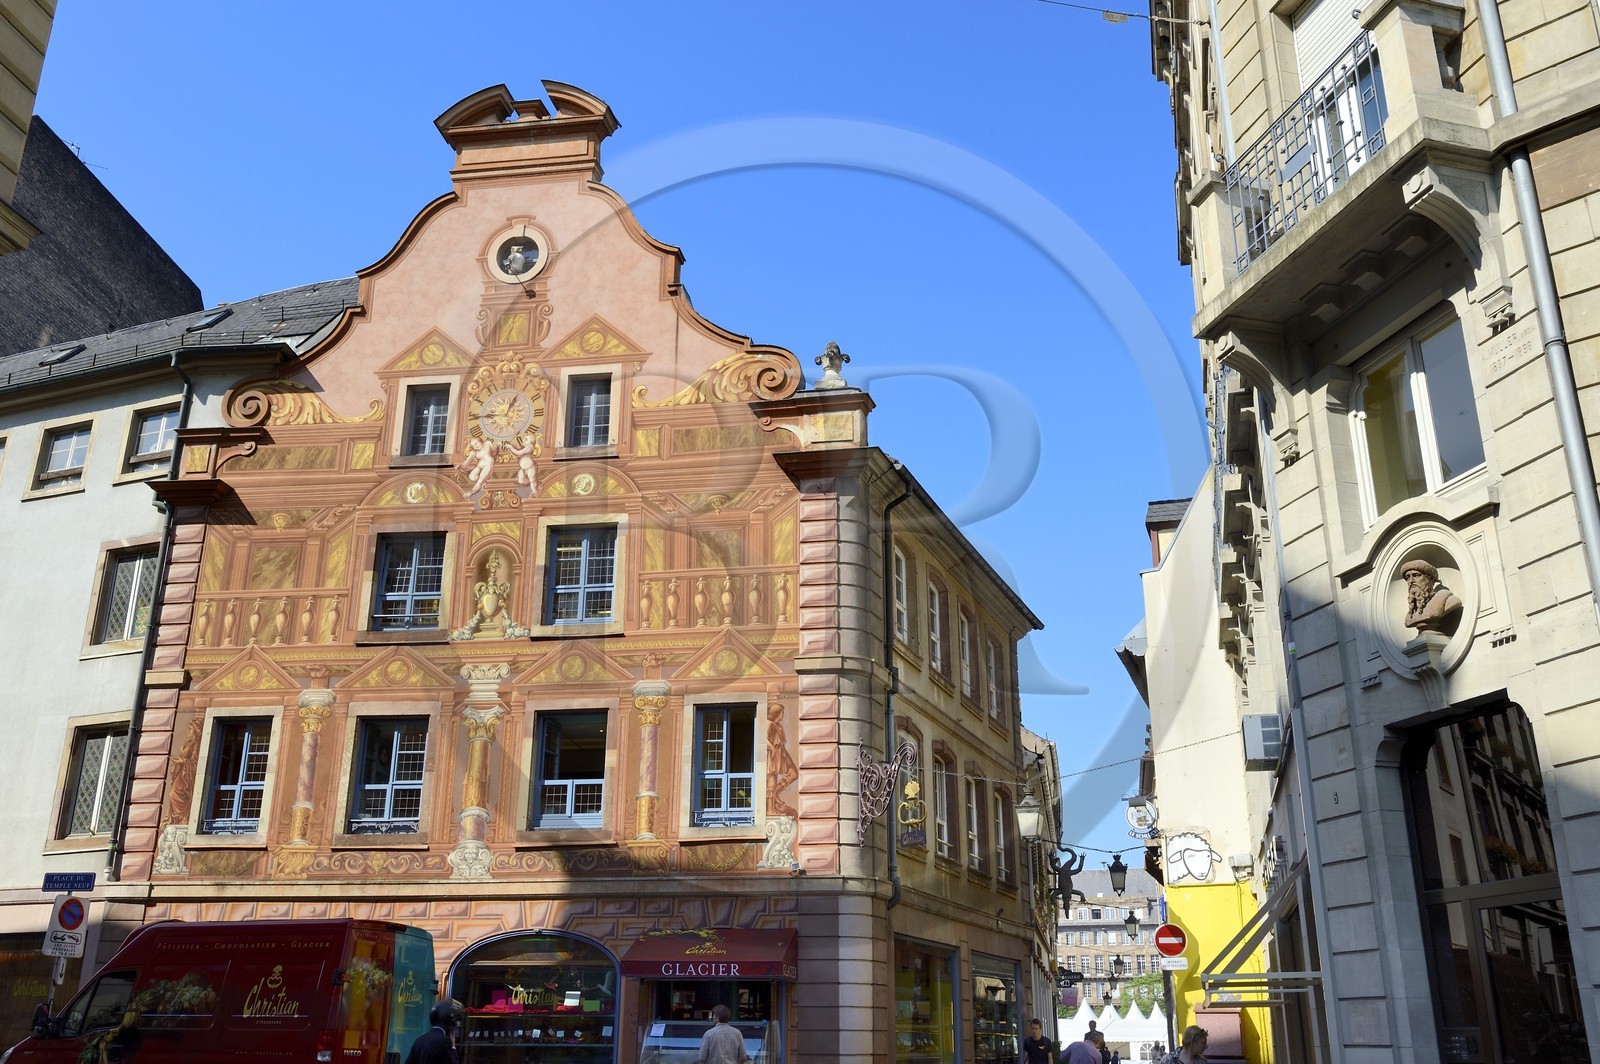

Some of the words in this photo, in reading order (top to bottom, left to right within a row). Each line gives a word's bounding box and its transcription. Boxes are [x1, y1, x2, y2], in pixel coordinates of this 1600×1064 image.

[685, 945, 727, 955] Christian
[661, 963, 740, 976] GLACIER
[243, 977, 300, 1018] Christian
[343, 1049, 362, 1057] IVECO
